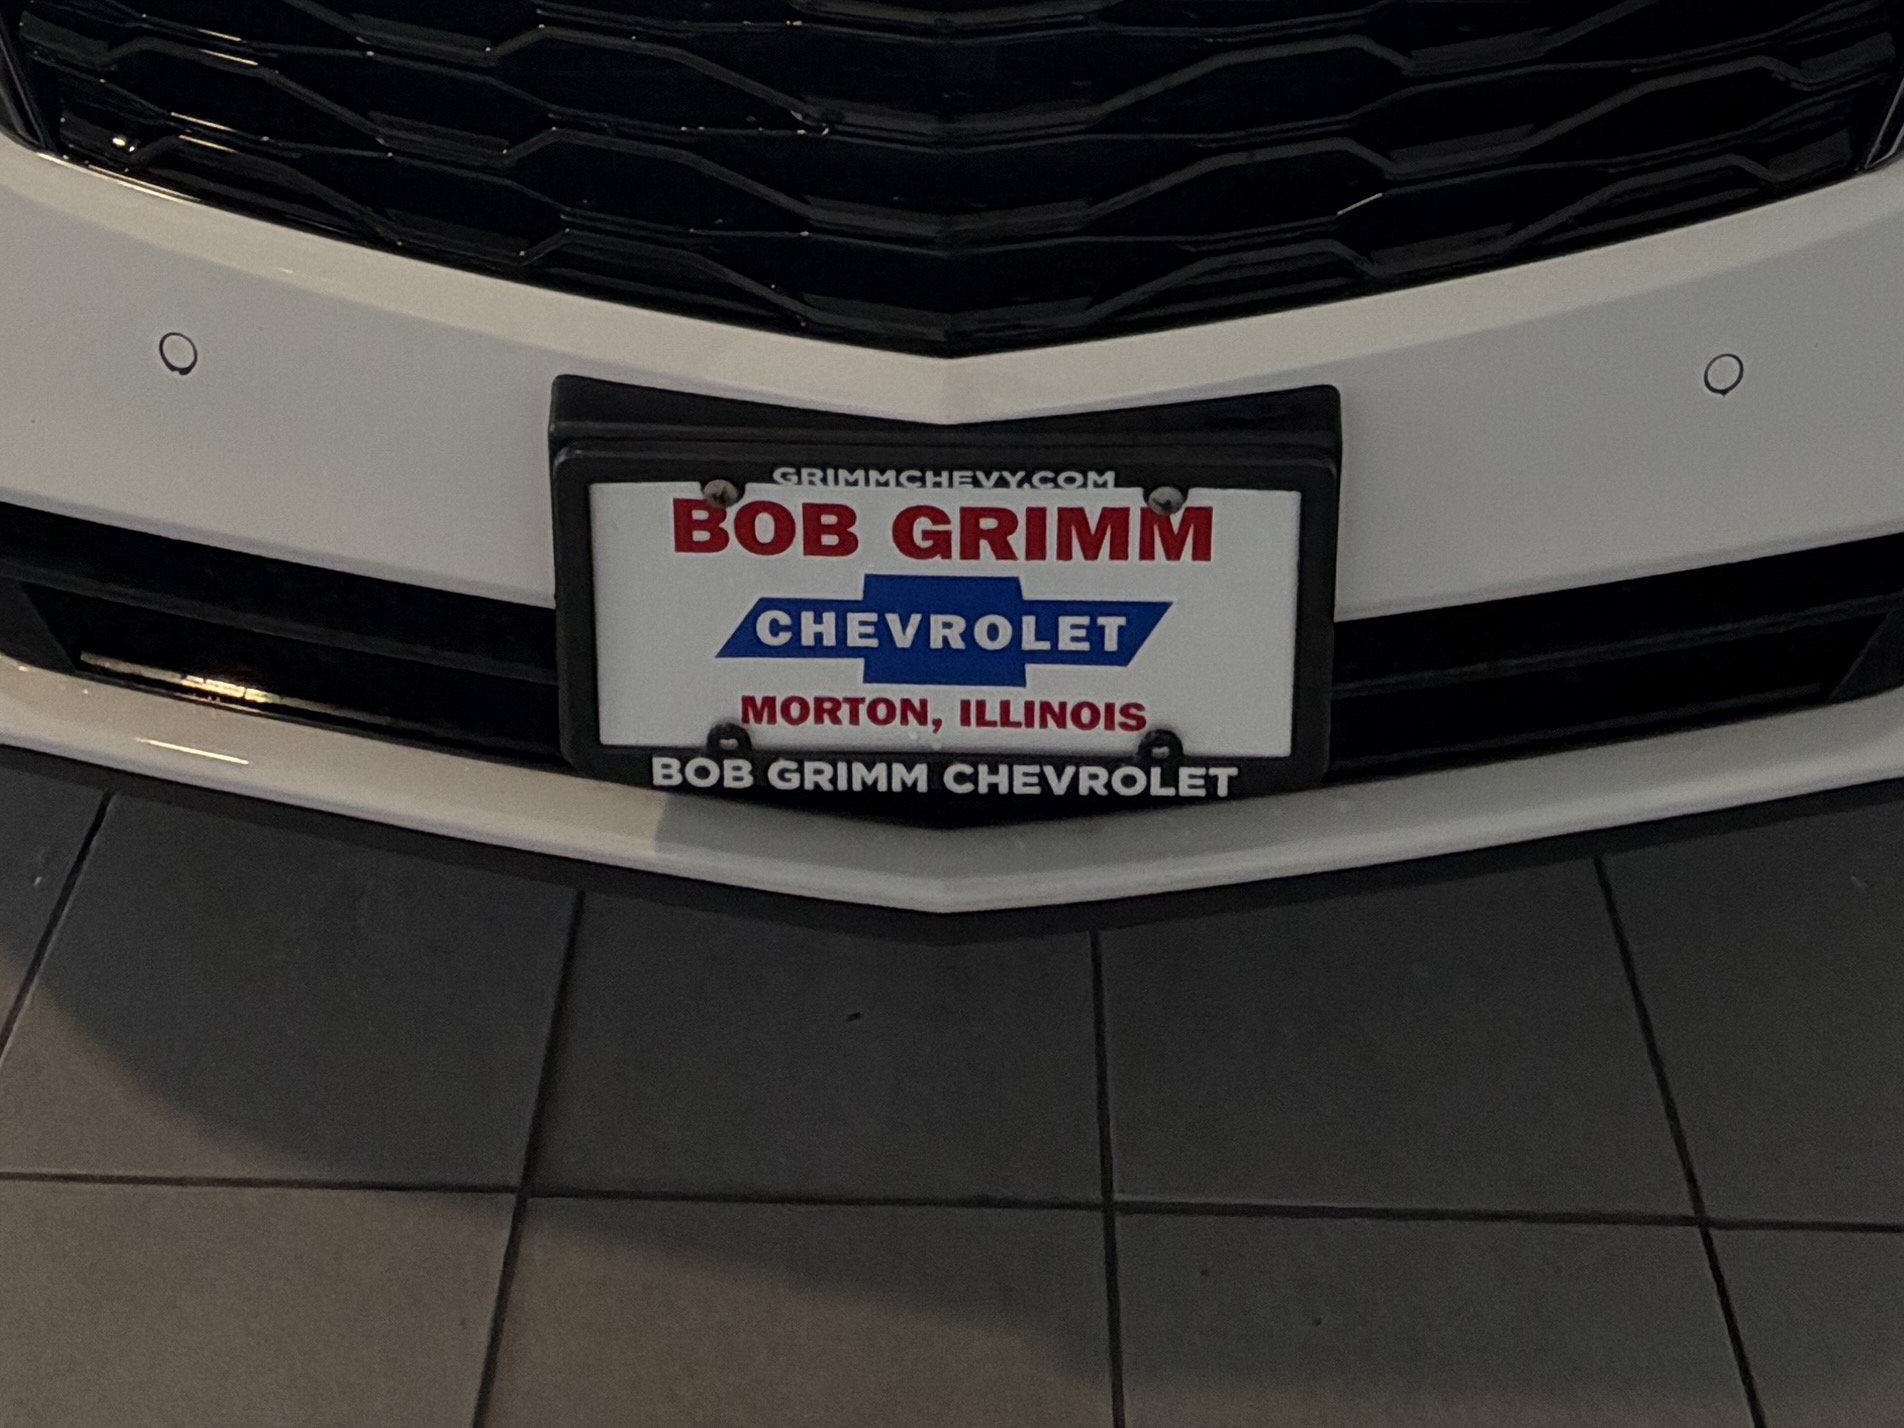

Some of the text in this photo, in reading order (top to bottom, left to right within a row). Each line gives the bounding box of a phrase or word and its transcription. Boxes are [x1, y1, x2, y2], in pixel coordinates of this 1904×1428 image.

[772, 466, 1116, 490] GRIMMCHEVY.COM
[672, 497, 1214, 562] BOB GRIMM
[755, 609, 1128, 654] CHEVROLET
[740, 695, 1148, 735] MORTON, ILLINOIS
[651, 756, 1239, 799] BOB GRIMM CHEVROLET
